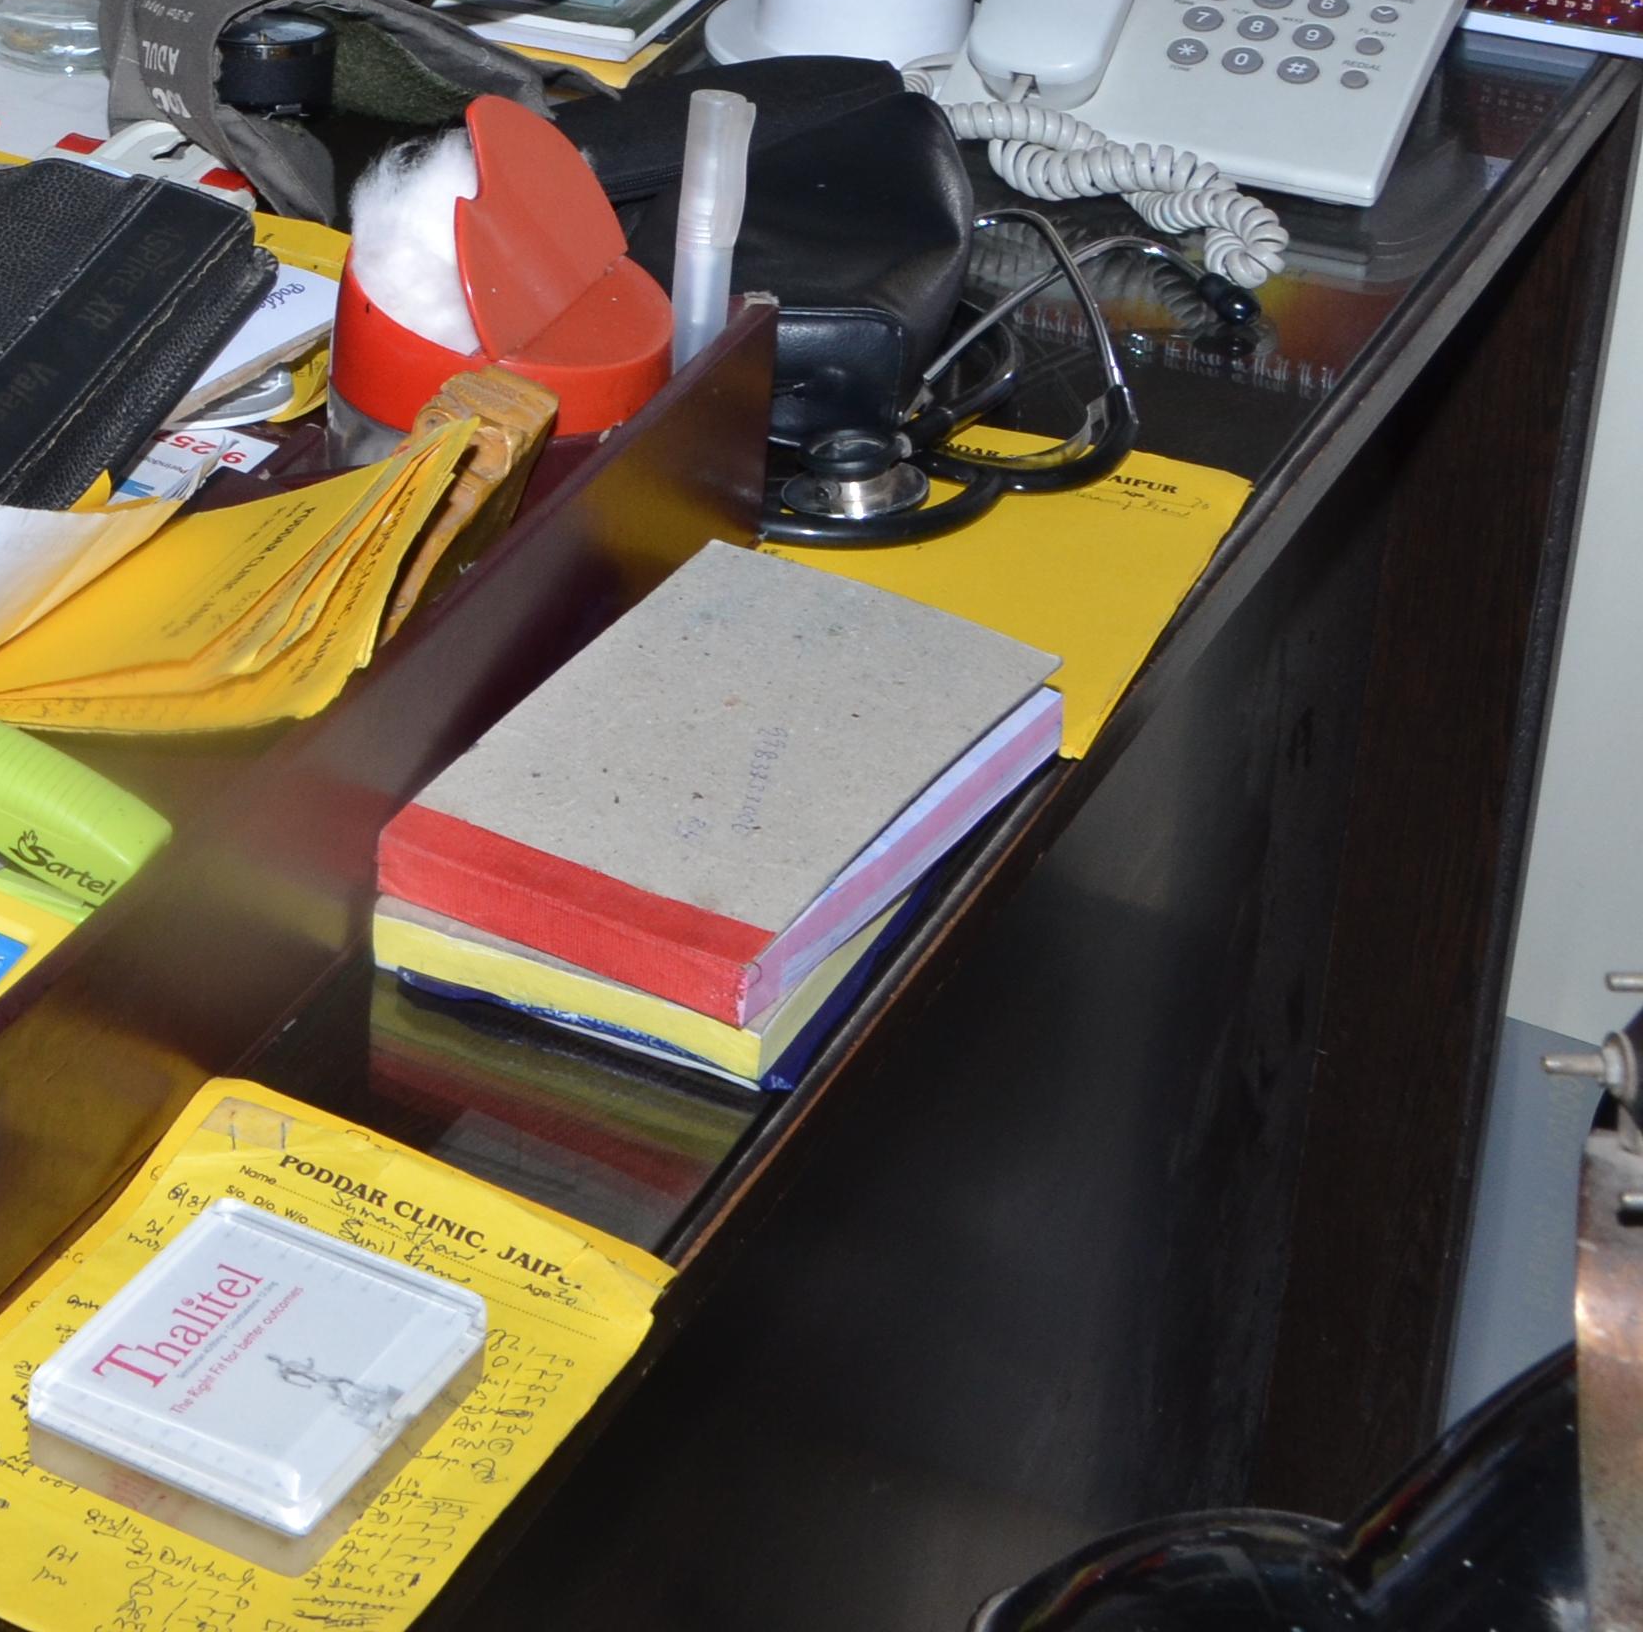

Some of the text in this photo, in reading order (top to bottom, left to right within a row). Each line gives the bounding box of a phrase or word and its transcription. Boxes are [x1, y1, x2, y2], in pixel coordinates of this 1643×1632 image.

[1195, 11, 1211, 23] 7
[1249, 20, 1265, 33] 8
[1305, 29, 1320, 42] 9
[1357, 27, 1397, 39] FLASH
[1234, 52, 1250, 66] 0
[1342, 59, 1383, 73] REDIAL
[1110, 473, 1178, 495] AIPUR
[8, 833, 118, 899] Sartel
[240, 1165, 277, 1187] Name
[225, 1183, 310, 1226] S/o, D/o, W/o
[278, 1153, 390, 1209] PODDAR
[393, 1200, 488, 1256] CLINIC,
[523, 1282, 552, 1301] Age
[91, 1262, 264, 1389] Thalitel
[169, 1284, 305, 1415] The Right Fit for better outcomes
